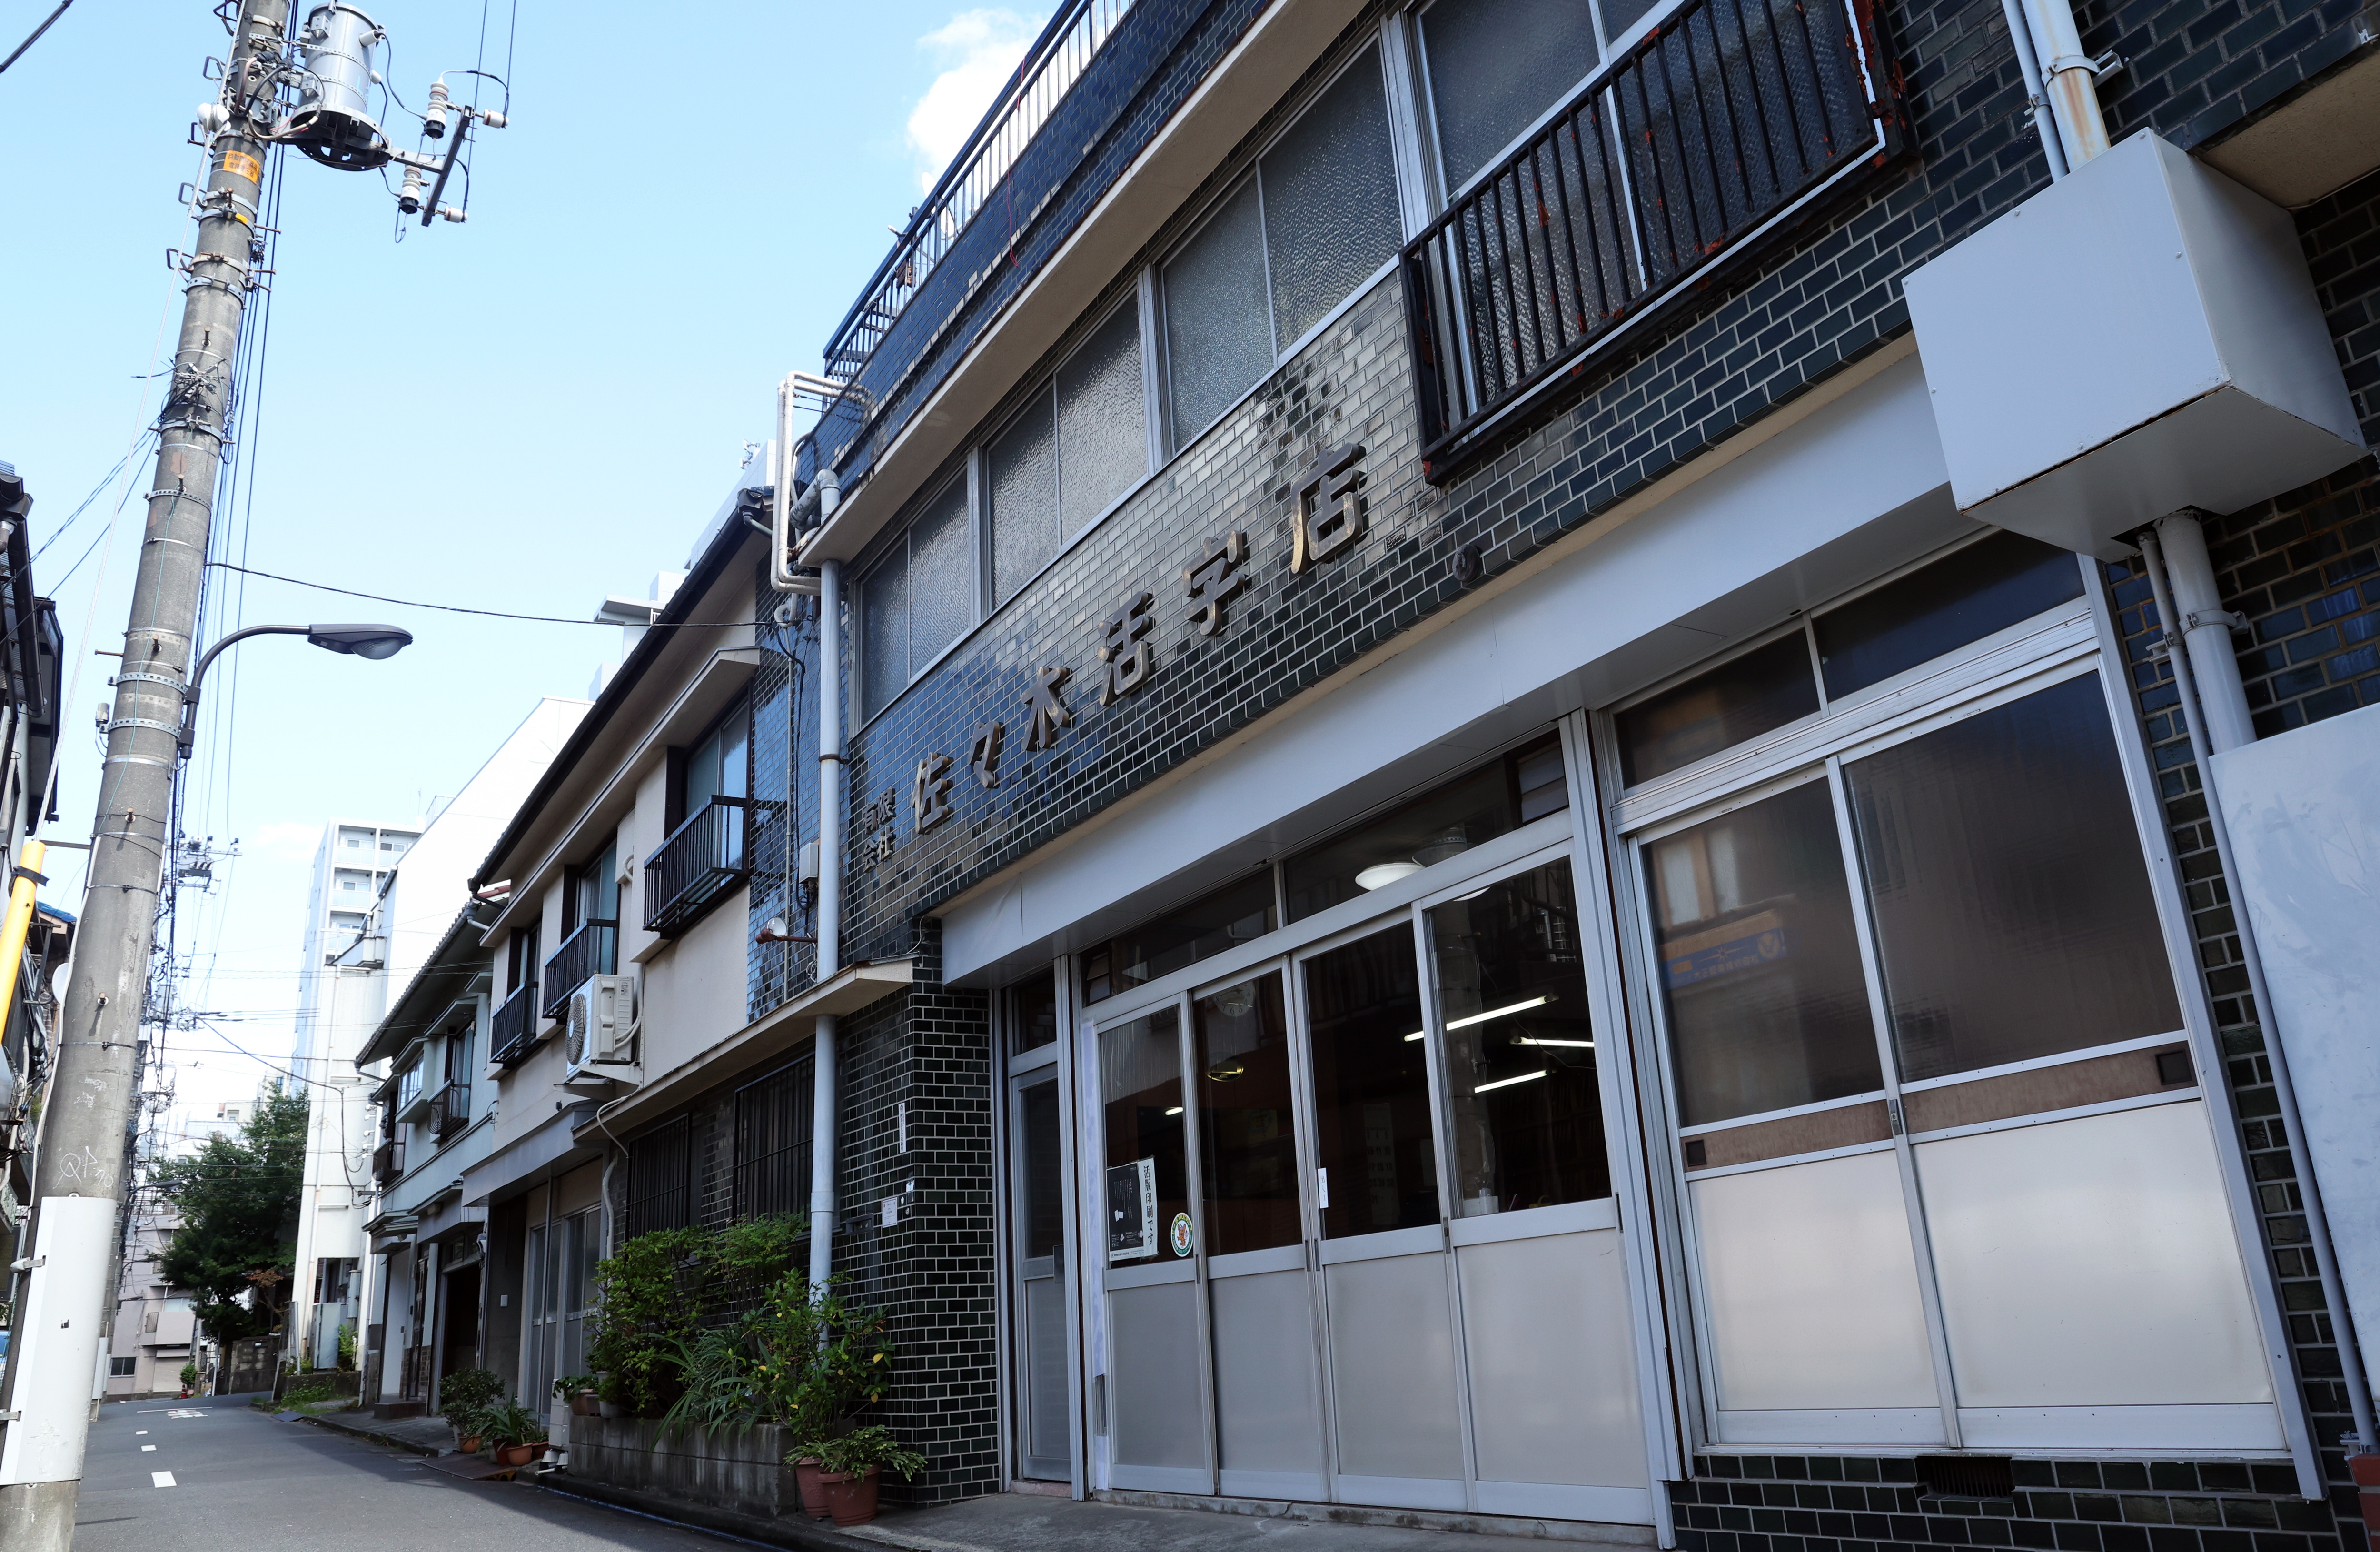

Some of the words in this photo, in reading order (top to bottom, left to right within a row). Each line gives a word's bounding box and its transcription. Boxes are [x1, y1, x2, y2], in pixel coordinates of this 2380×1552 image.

[910, 443, 1362, 834] 佐々木活字店
[862, 788, 893, 835] 有限
[862, 826, 894, 873] 会社
[1143, 1165, 1153, 1246] 活版印刷です
